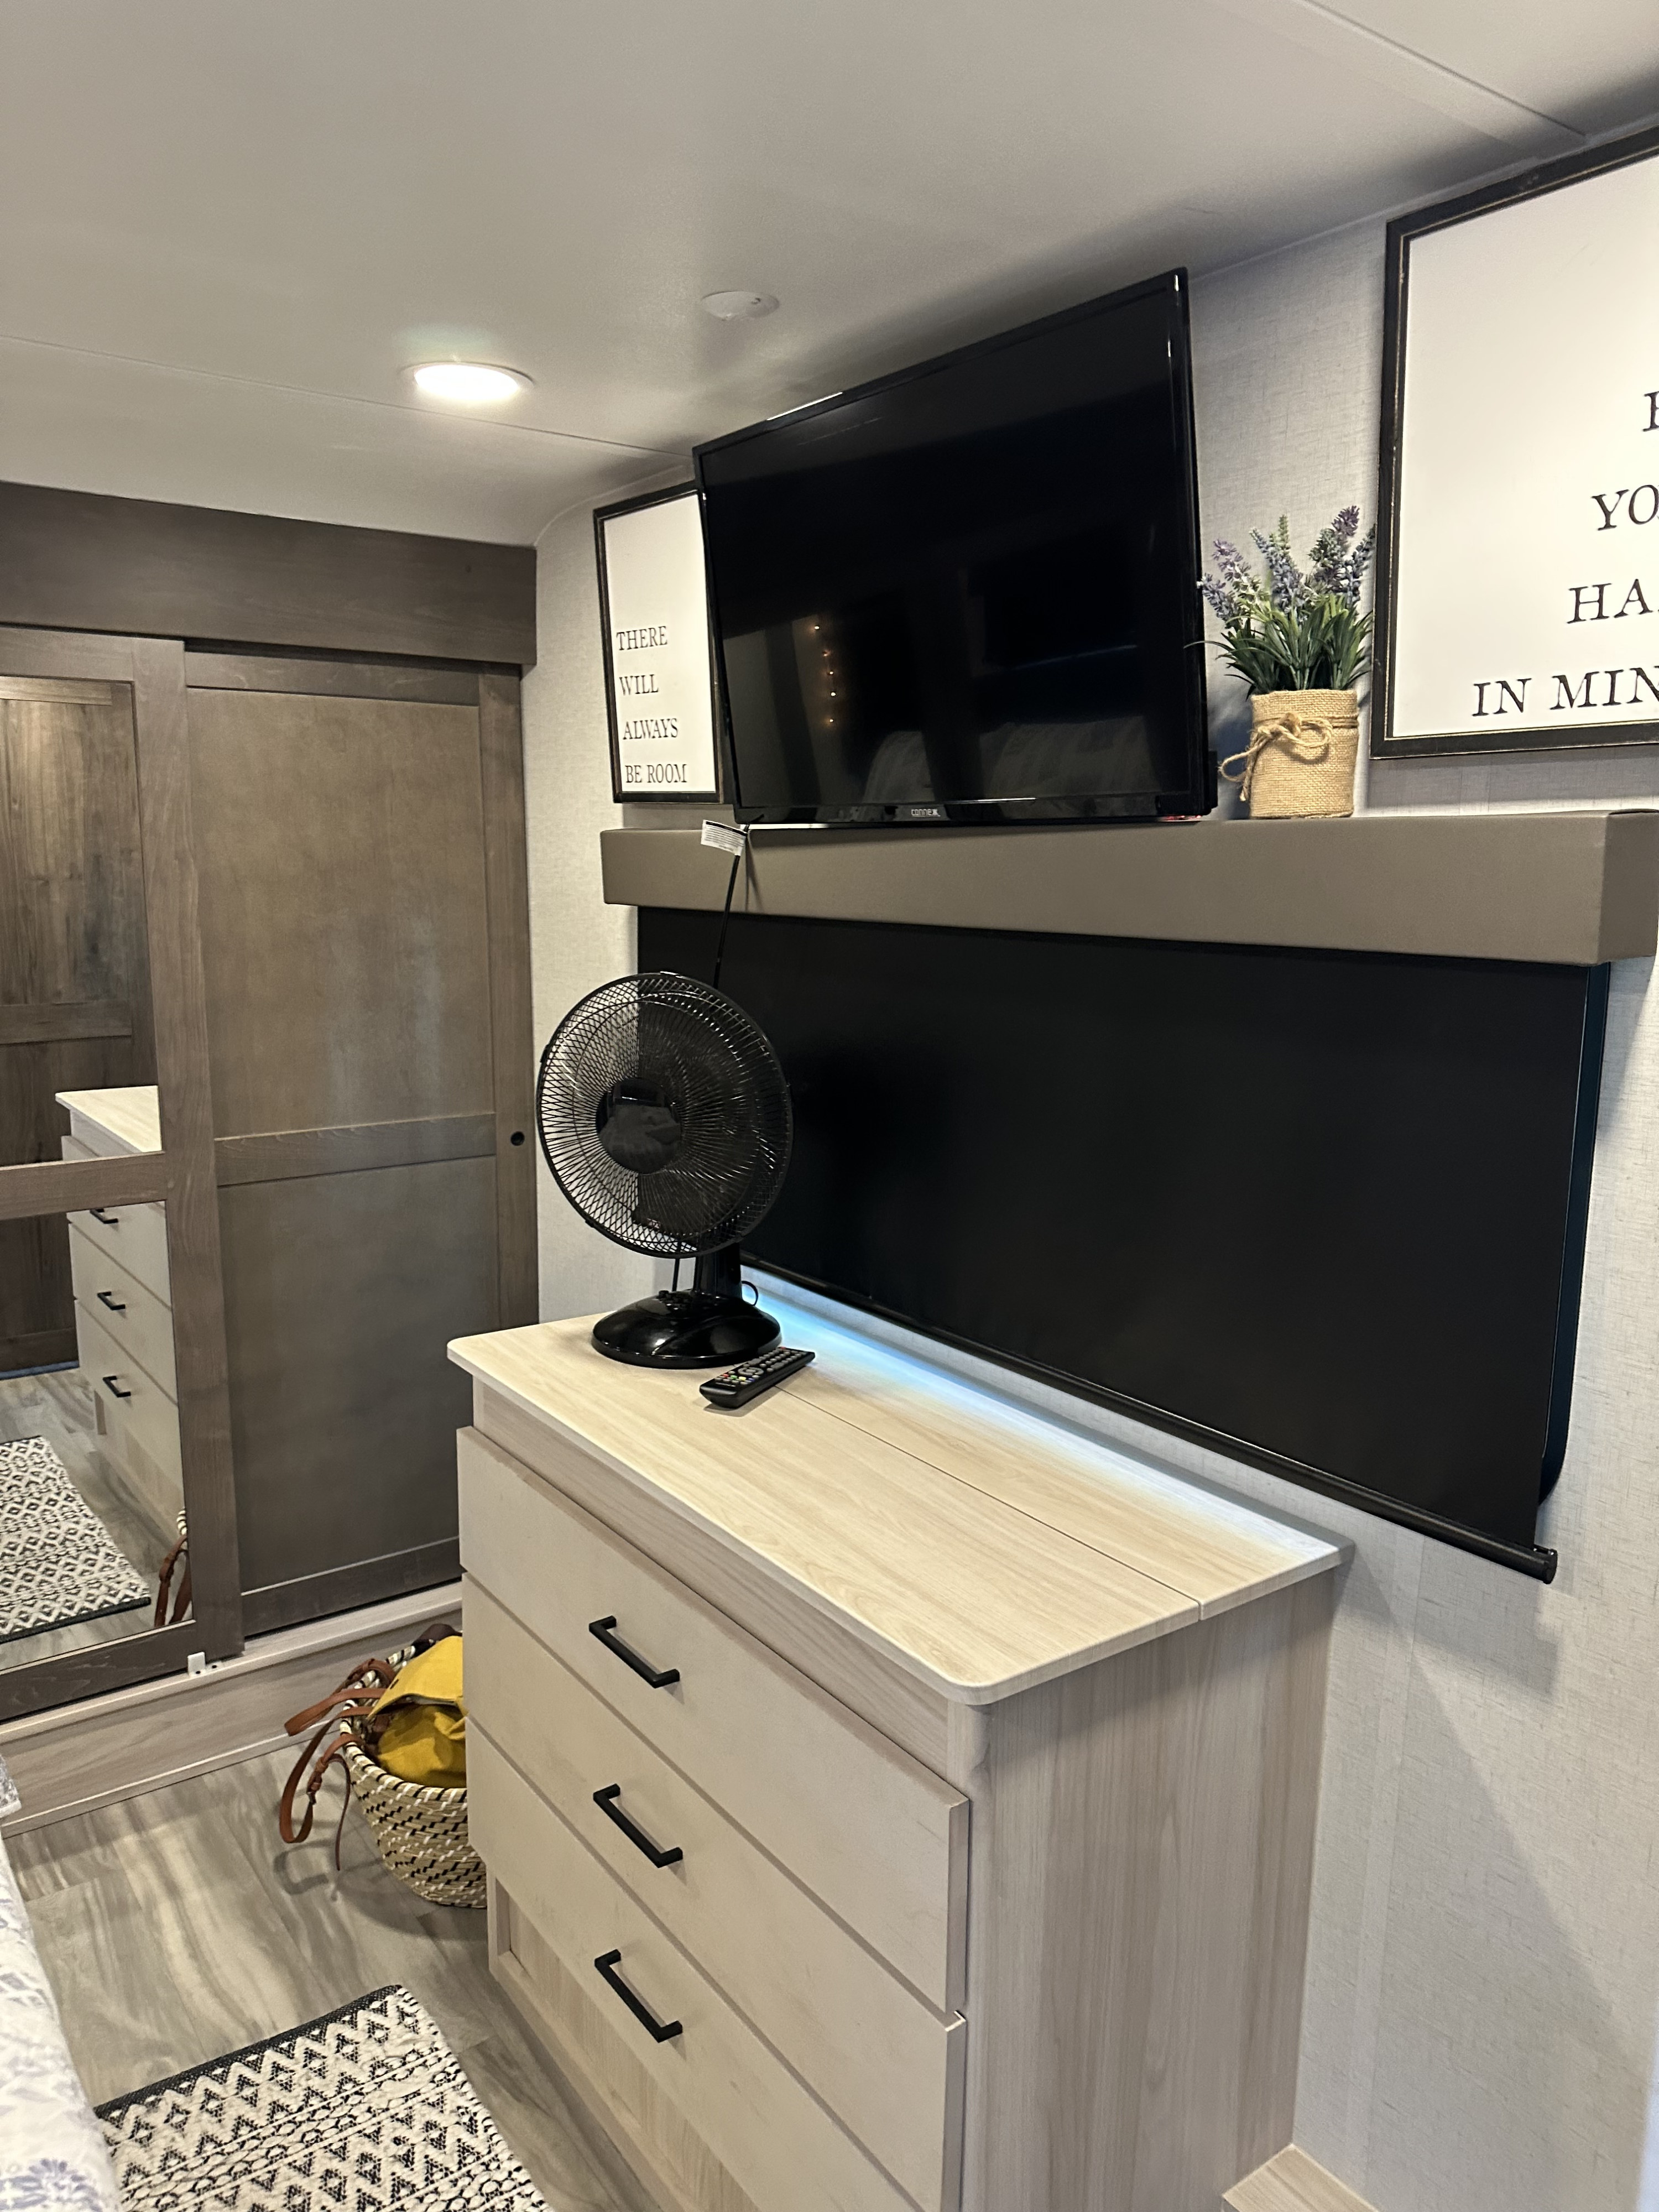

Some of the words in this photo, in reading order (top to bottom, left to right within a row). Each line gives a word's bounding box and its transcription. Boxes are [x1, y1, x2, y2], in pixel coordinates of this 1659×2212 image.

[1590, 484, 1659, 531] YO
[1566, 578, 1659, 624] HA
[616, 625, 667, 651] THERE
[619, 674, 659, 696] WILL
[1472, 677, 1532, 717] IN
[623, 718, 679, 740] ALWAYS
[625, 765, 643, 784] BE
[646, 764, 687, 783] ROOM
